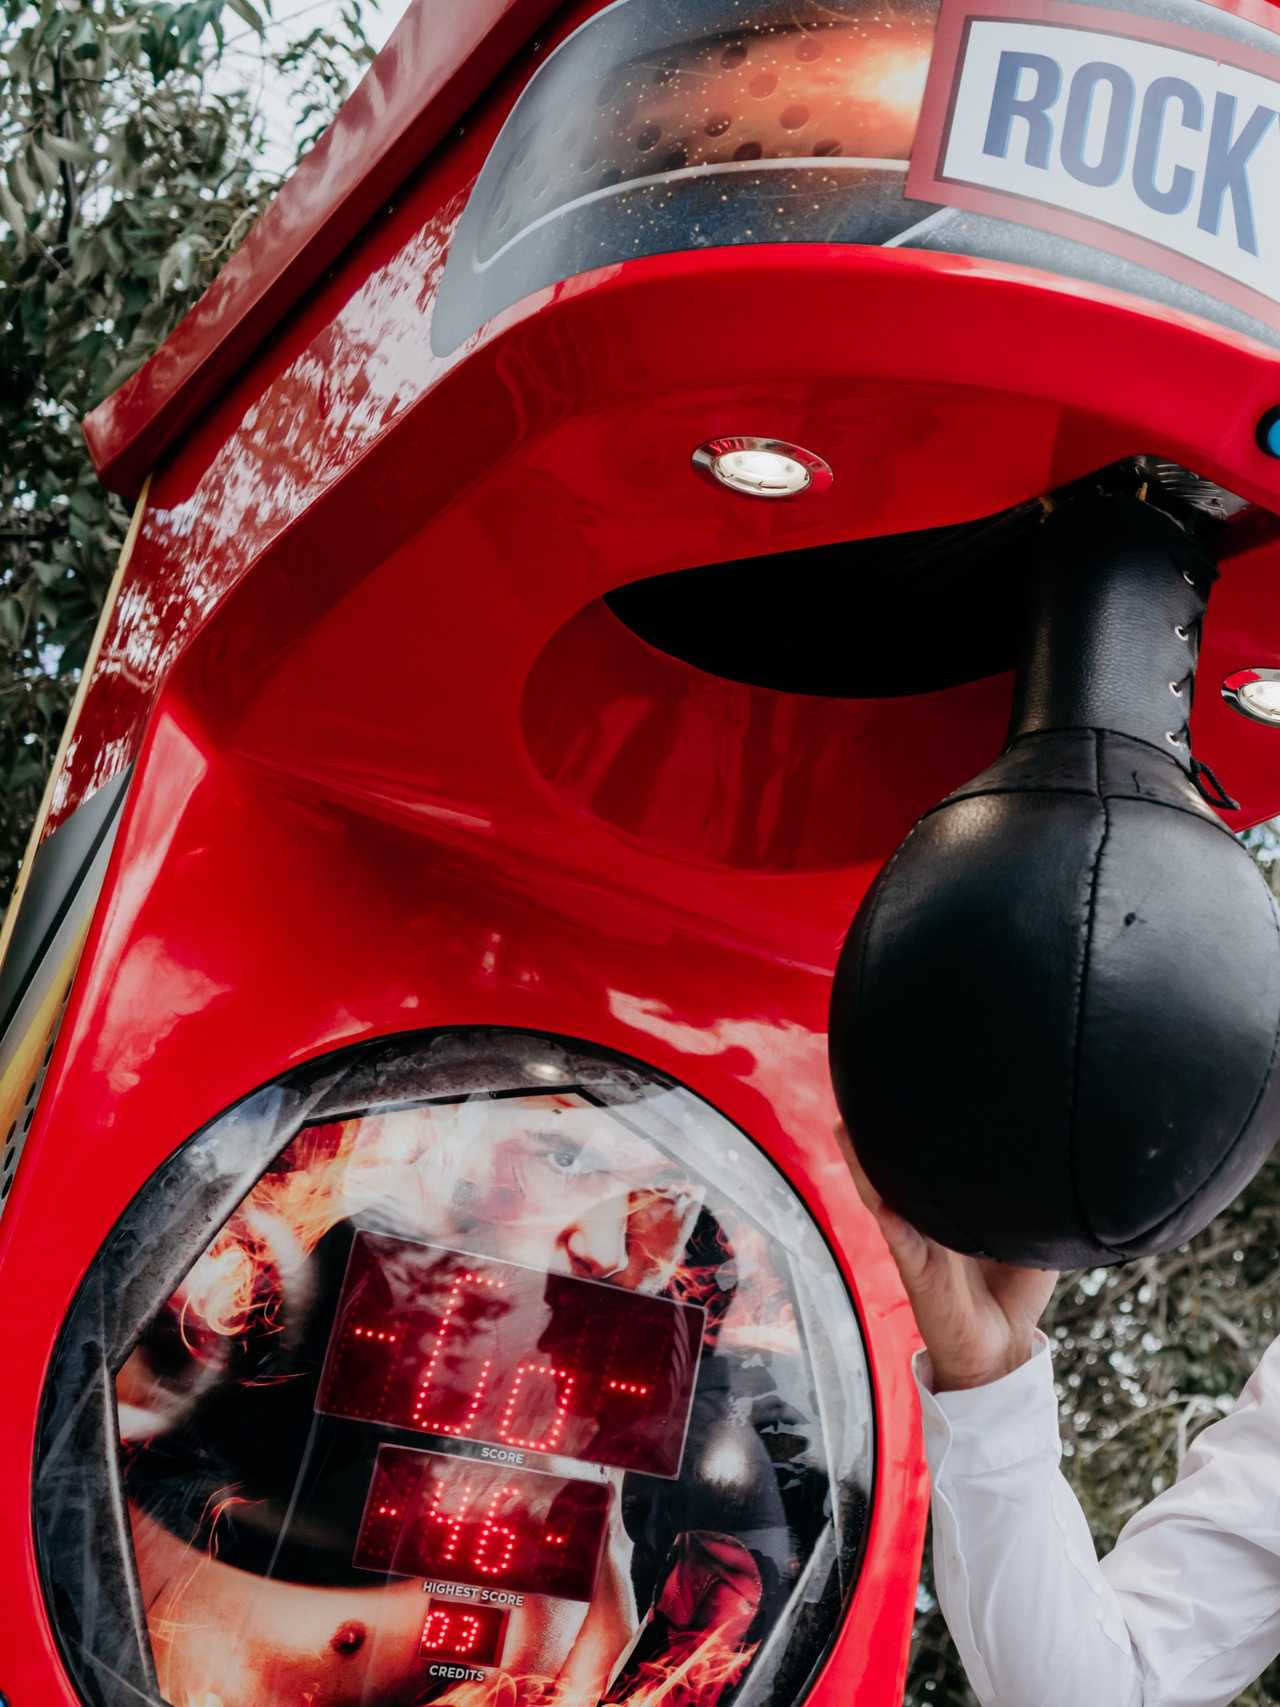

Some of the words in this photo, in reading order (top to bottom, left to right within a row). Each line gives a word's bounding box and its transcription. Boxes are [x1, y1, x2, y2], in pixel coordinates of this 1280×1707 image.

[481, 1447, 524, 1464] SCORE
[422, 1581, 480, 1600] HIGHEST
[480, 1590, 525, 1607] SCORE
[421, 1611, 479, 1652] 03
[429, 1665, 485, 1682] CREDITS
